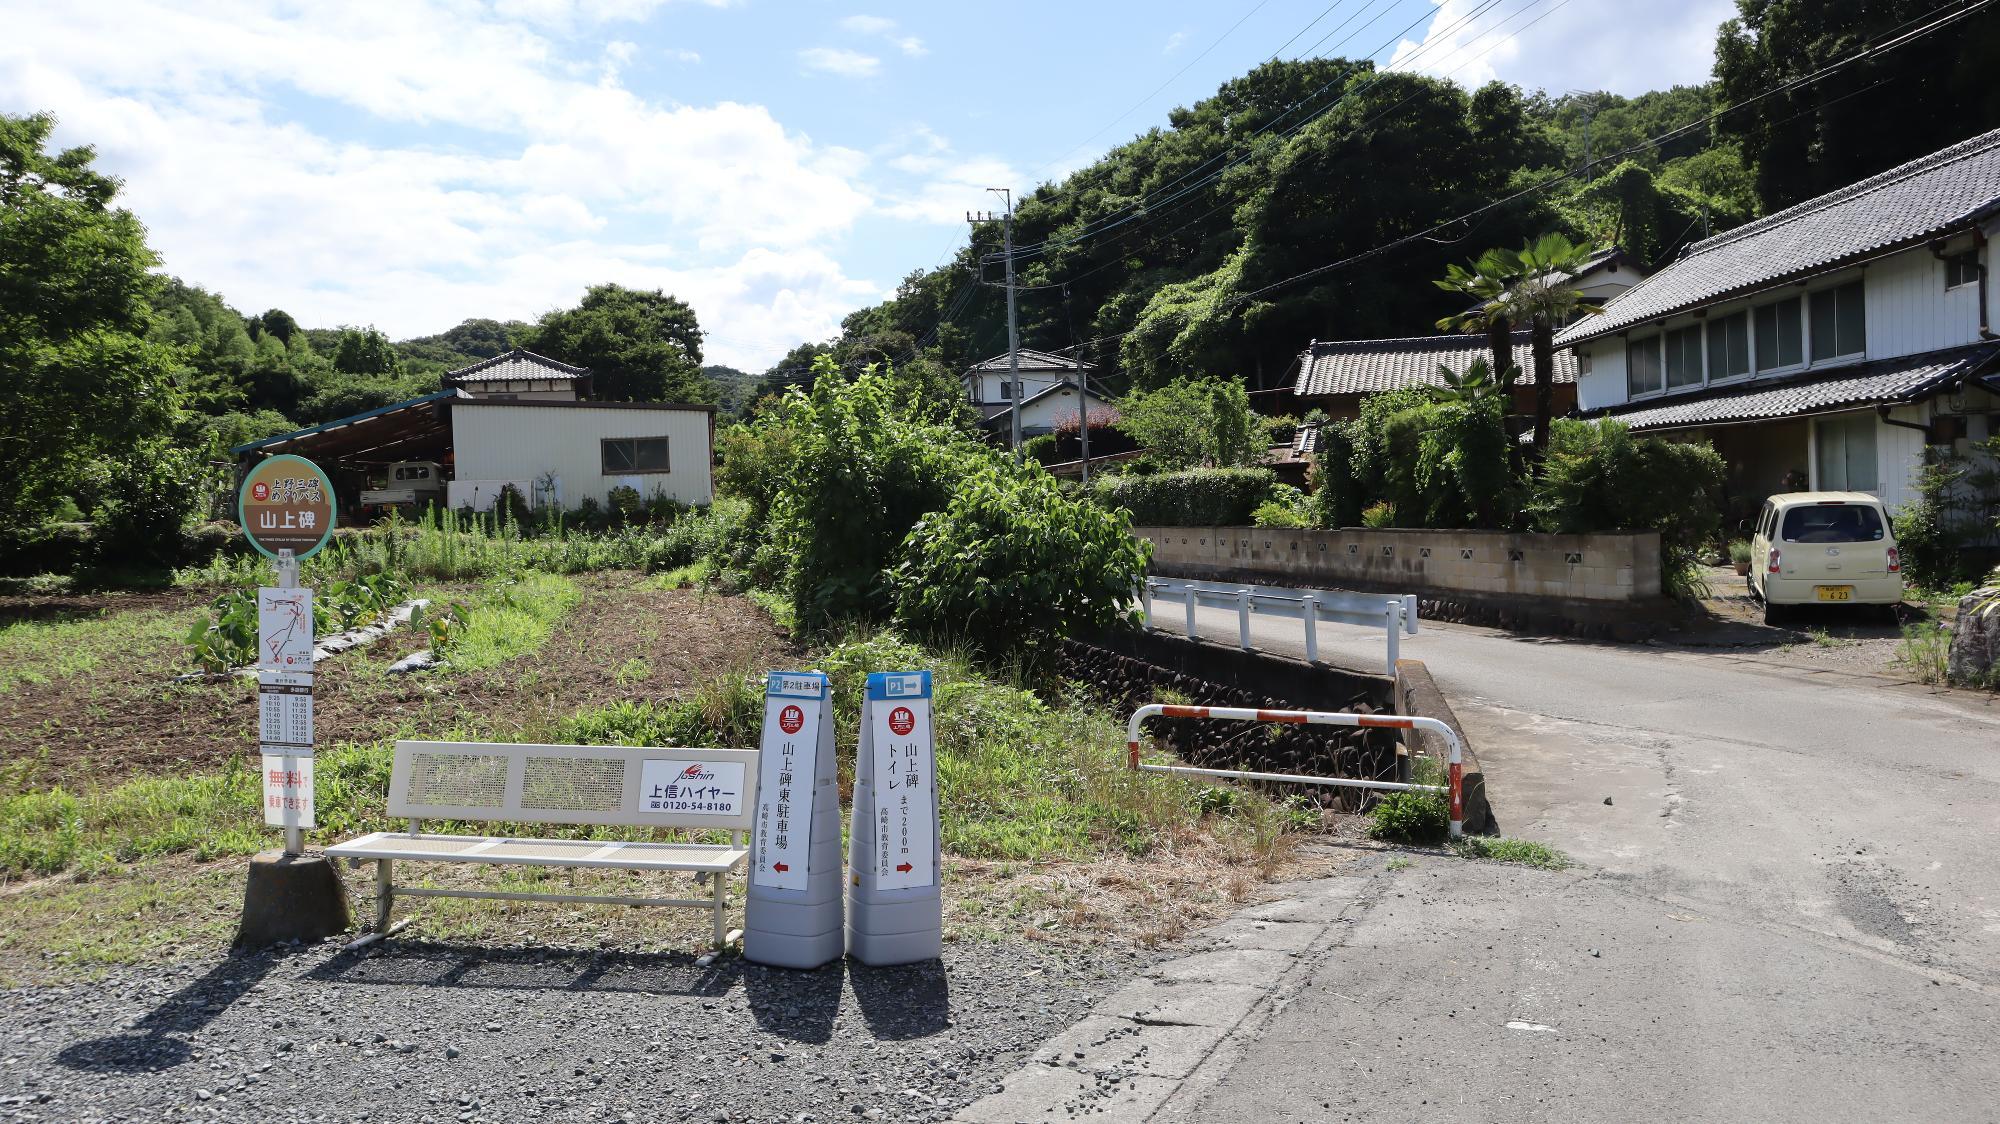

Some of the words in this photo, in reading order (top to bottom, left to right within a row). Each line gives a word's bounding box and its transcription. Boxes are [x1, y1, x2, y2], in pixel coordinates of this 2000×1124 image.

[272, 477, 319, 490] 上野三碑
[271, 490, 320, 502] めぐりバス
[260, 510, 316, 529] 山上碑
[770, 679, 781, 689] P2
[890, 681, 902, 691] P1
[887, 743, 900, 790] トイレ
[905, 742, 919, 789] 山上碑
[649, 784, 735, 800] 上信ハイヤー
[775, 741, 795, 850] 山上碑東駐車場
[269, 794, 309, 810] 乗車できます
[663, 801, 732, 812] 0120-54-8180
